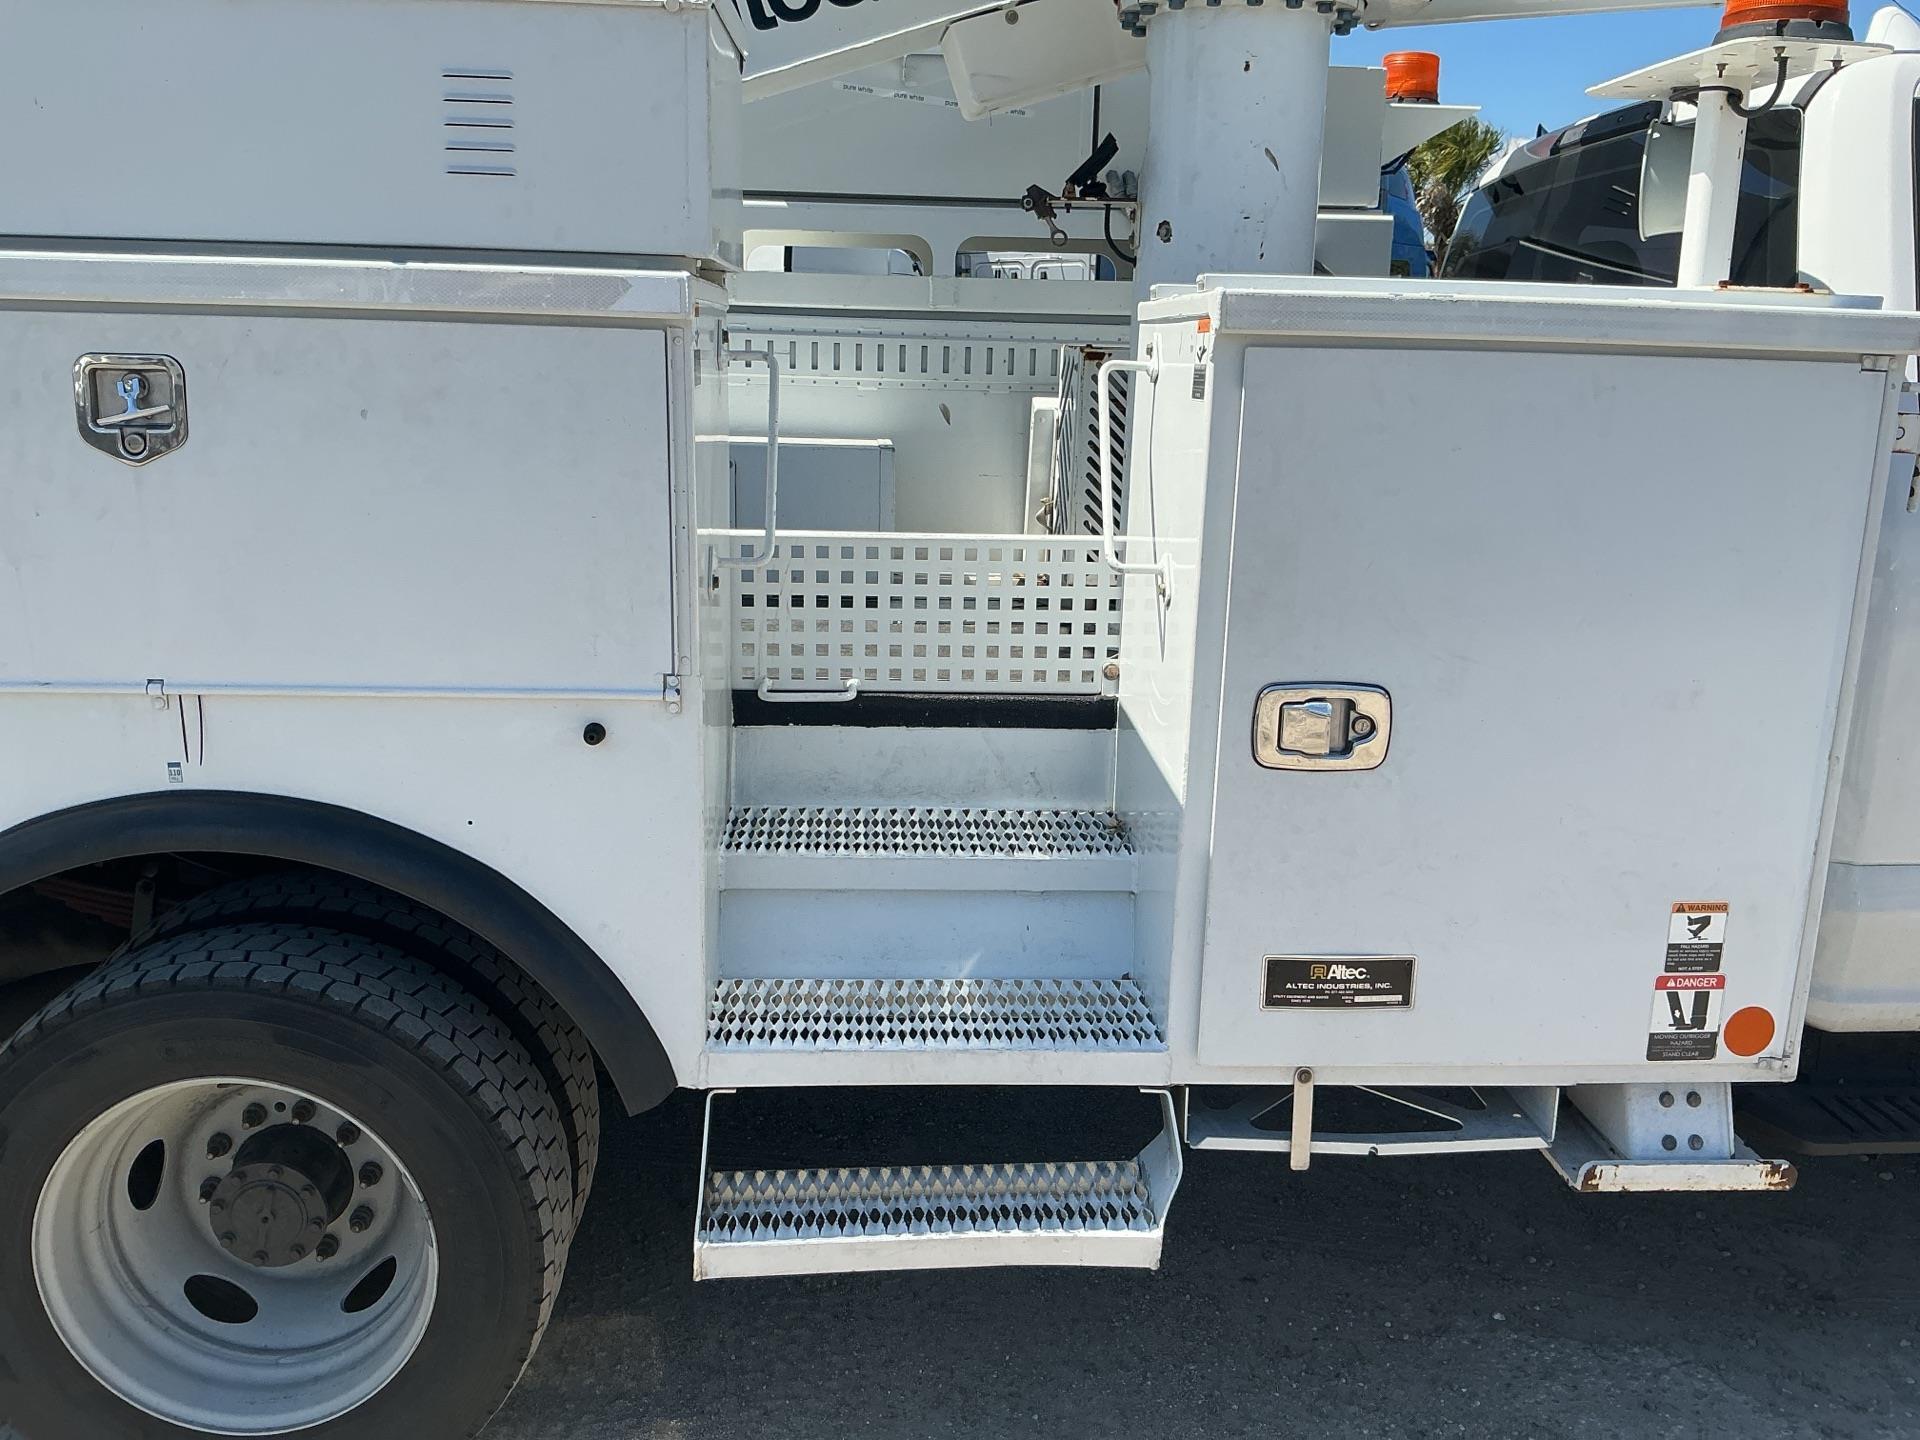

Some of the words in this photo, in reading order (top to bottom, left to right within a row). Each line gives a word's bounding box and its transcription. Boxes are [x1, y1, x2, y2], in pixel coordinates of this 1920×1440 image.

[858, 86, 874, 94] white
[1687, 904, 1728, 912] WARNING
[1327, 964, 1367, 980] Altec
[1285, 982, 1315, 990] ALTEC
[1316, 982, 1373, 991] INDUSTRIES,
[1676, 977, 1718, 988] DANGER
